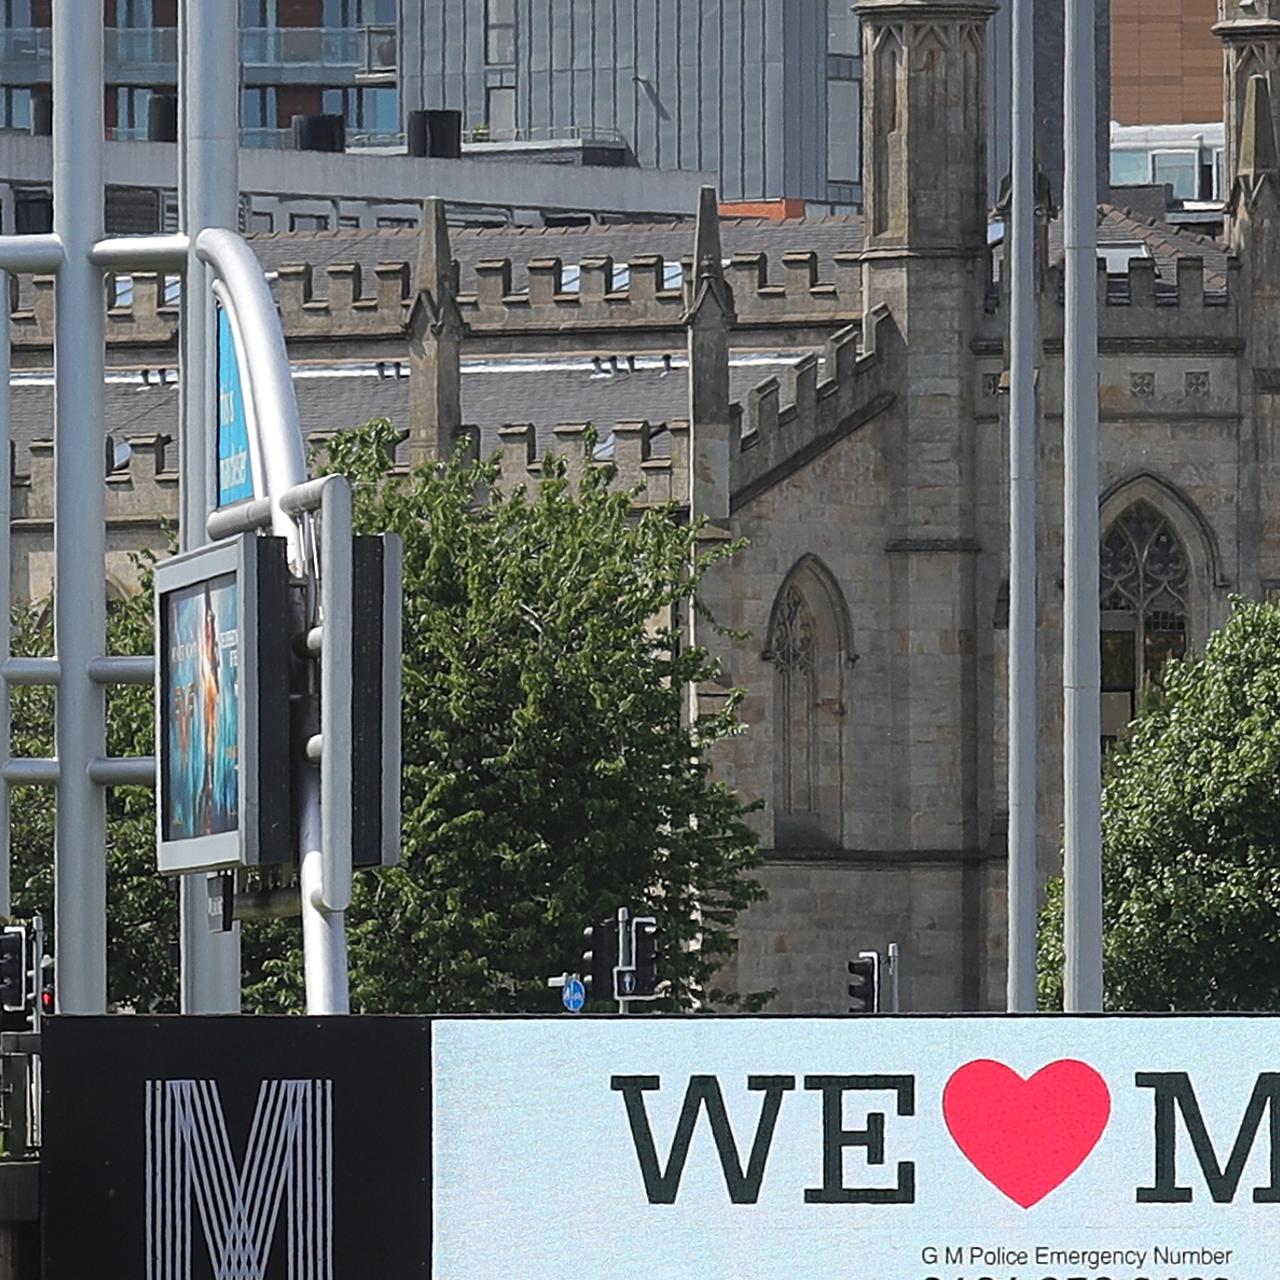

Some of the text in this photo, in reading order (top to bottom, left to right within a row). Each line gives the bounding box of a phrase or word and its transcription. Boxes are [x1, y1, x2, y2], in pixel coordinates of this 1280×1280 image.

[611, 1074, 915, 1205] WE
[921, 1246, 1233, 1270] G M Police Emergency Number
